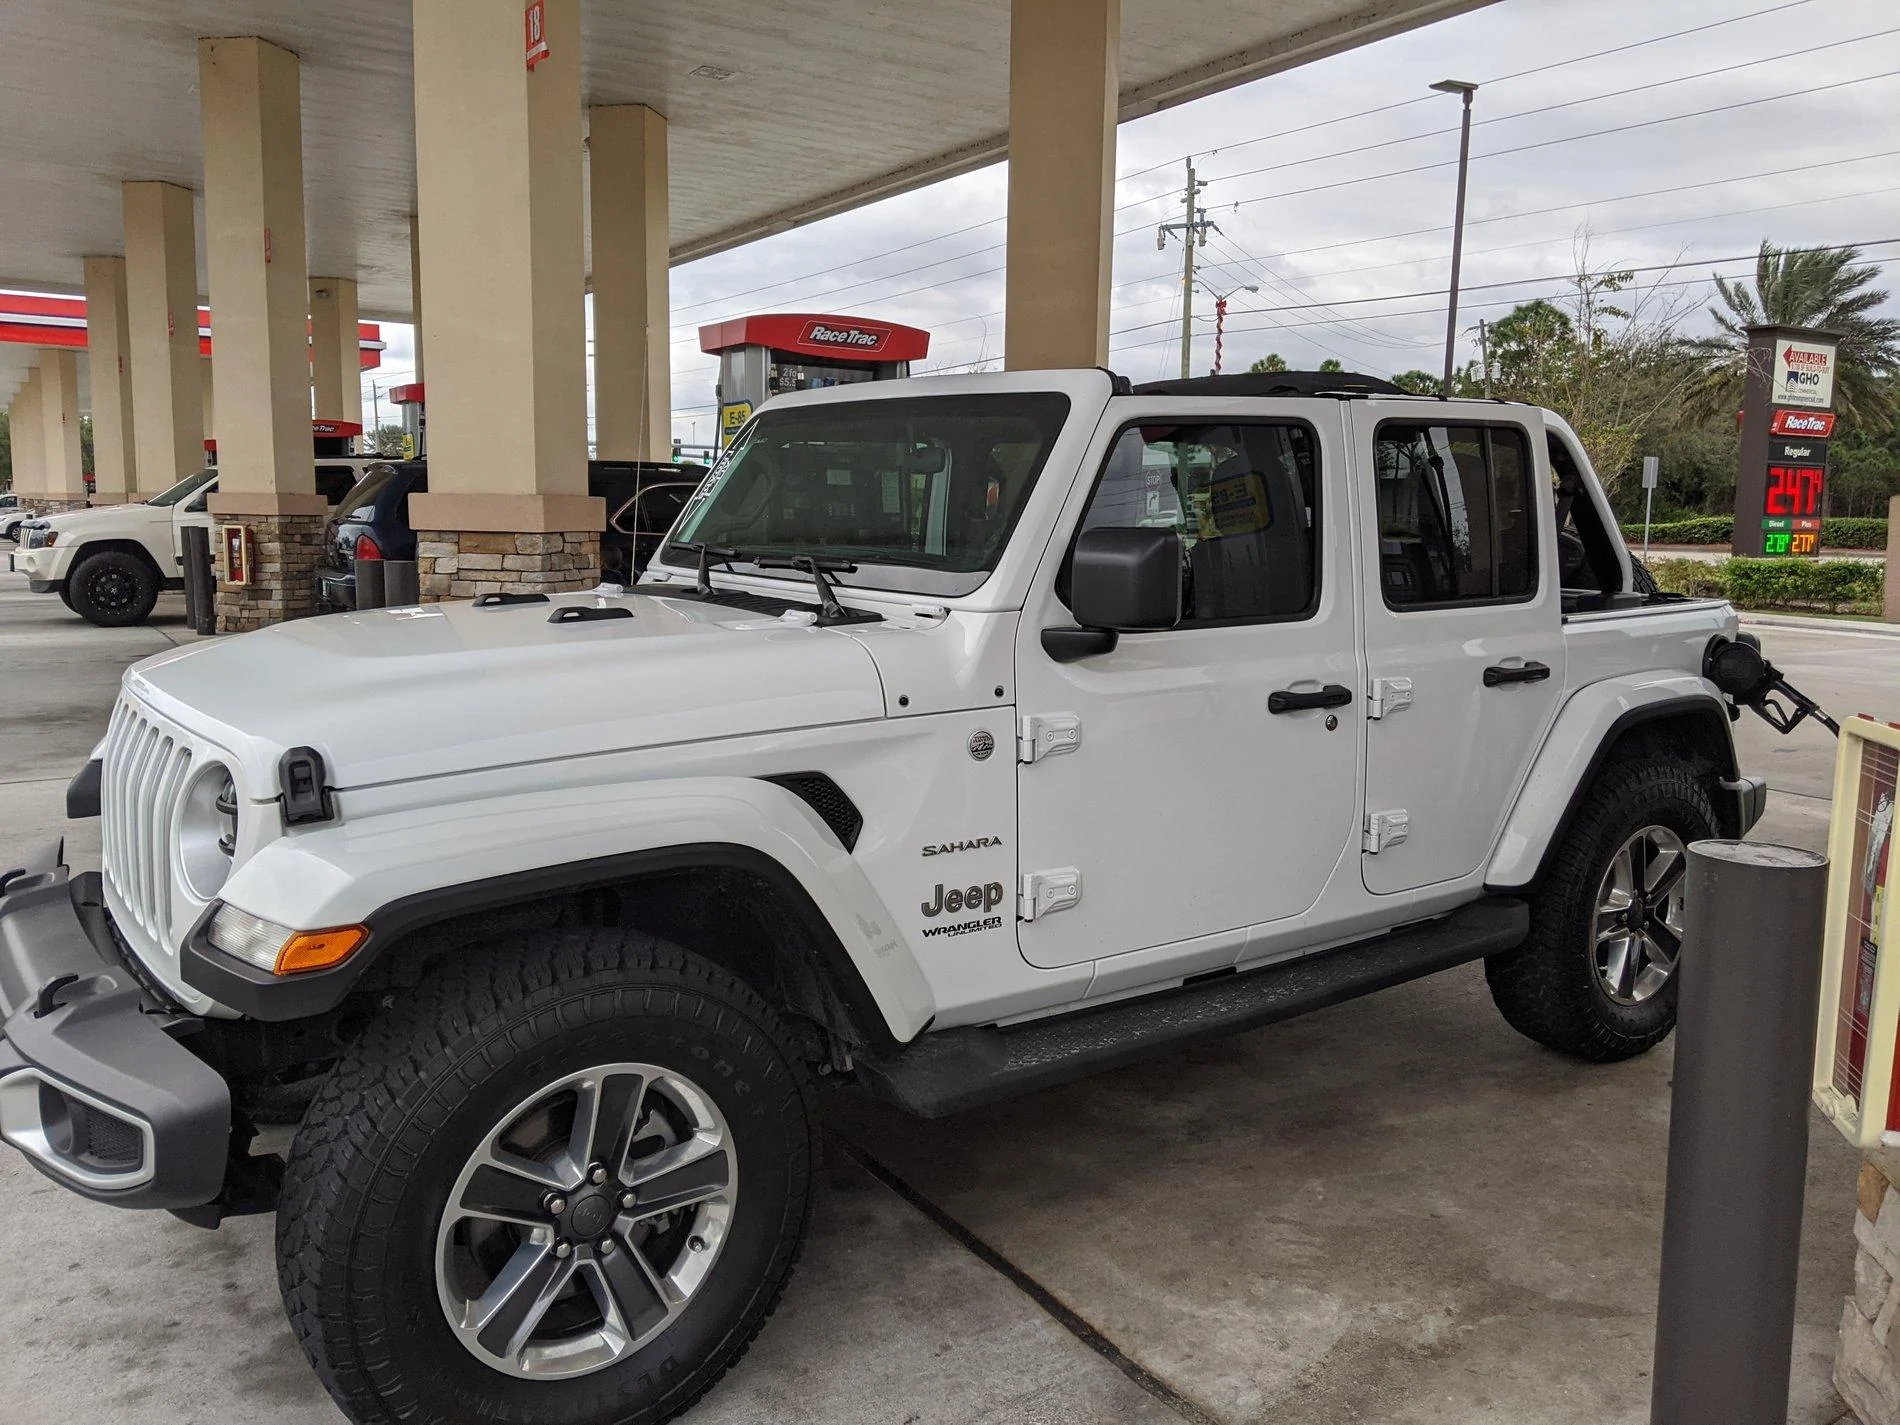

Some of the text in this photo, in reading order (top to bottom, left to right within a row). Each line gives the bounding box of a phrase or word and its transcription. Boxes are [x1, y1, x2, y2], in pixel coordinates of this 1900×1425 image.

[529, 5, 540, 43] 18
[809, 325, 878, 347] RaceTrac
[1789, 351, 1827, 365] AVAILABLE
[779, 377, 797, 387] $5.5
[1799, 372, 1820, 386] GHO
[729, 410, 746, 425] E-85
[1784, 415, 1826, 431] RaceTrac
[312, 425, 335, 433] eTrac
[1784, 446, 1811, 458] Regular
[1147, 475, 1160, 485] STOP
[1768, 520, 1785, 528] Diesel
[1801, 520, 1812, 528] Plus
[921, 836, 1003, 857] SAHARA
[920, 881, 1004, 918] Jeep
[921, 916, 1003, 938] WRANGLER
[947, 923, 1003, 938] UNLIMITED
